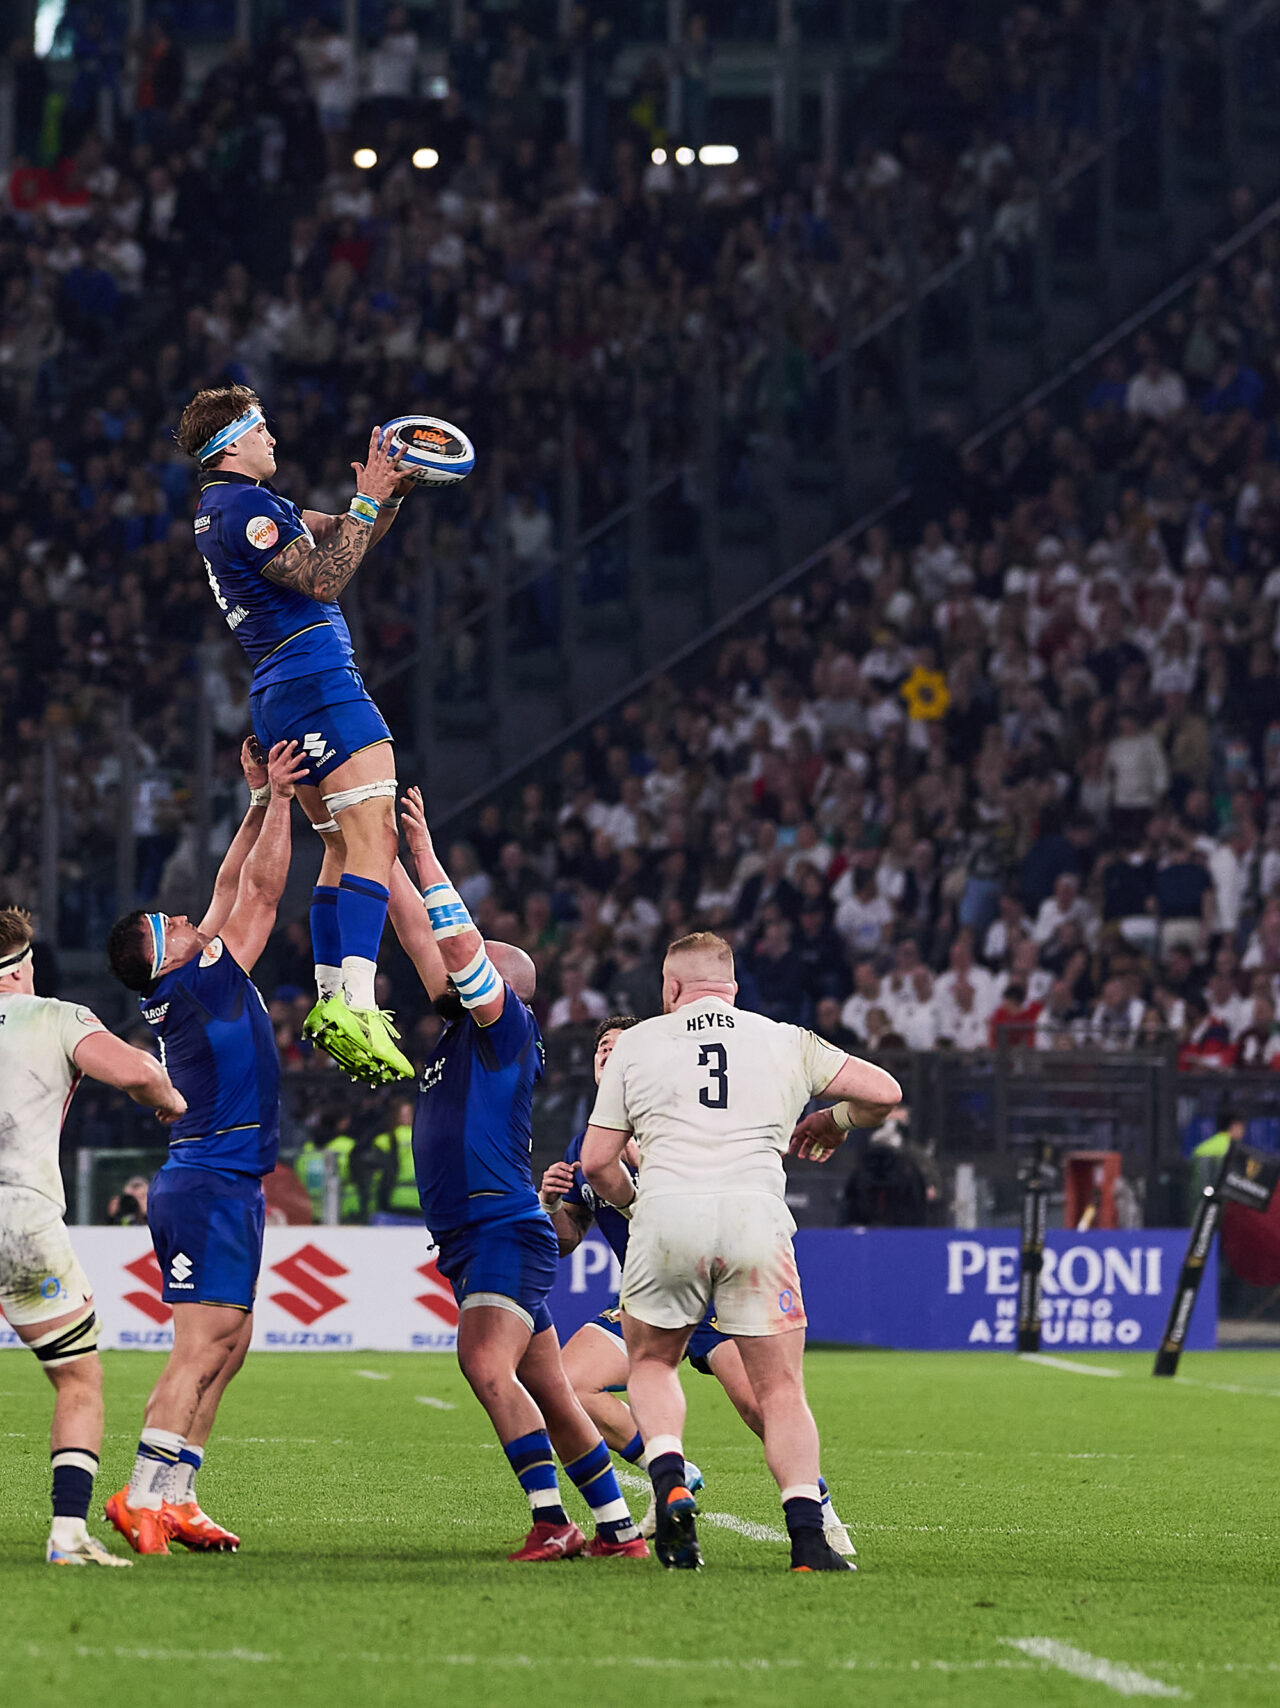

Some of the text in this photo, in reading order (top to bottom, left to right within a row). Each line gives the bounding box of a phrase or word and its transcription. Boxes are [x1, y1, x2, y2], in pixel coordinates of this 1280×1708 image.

[686, 1012, 736, 1032] HEYES
[697, 1042, 729, 1110] 3
[947, 1241, 1164, 1296] PERONI
[996, 1298, 1114, 1319] NSTRO
[265, 1331, 354, 1346] SUZUKI
[411, 1333, 457, 1347] SUZ
[968, 1319, 1143, 1344] AZURRO
